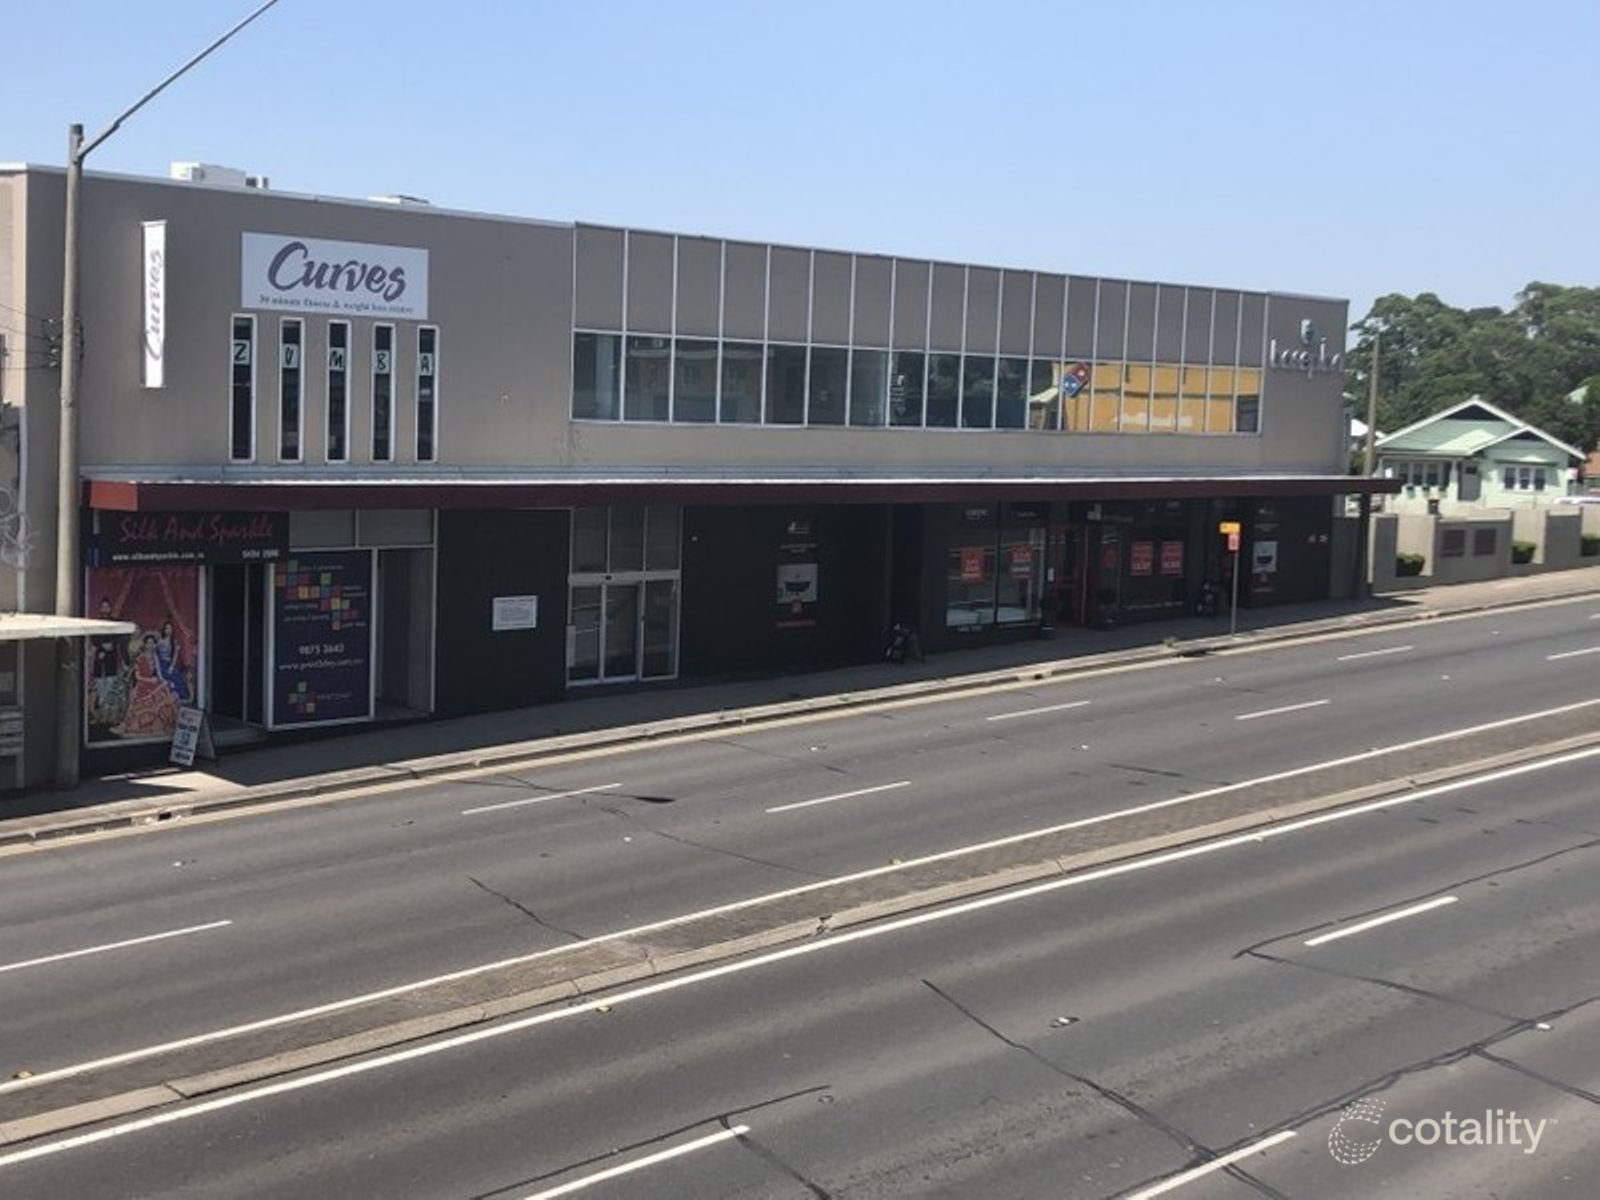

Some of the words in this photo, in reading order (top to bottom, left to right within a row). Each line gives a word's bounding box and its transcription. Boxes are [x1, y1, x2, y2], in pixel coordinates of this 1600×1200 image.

[267, 240, 407, 302] Curves
[145, 248, 163, 361] Curves
[119, 514, 157, 542] Silk
[163, 513, 204, 540] And
[209, 513, 273, 543] Sparkle
